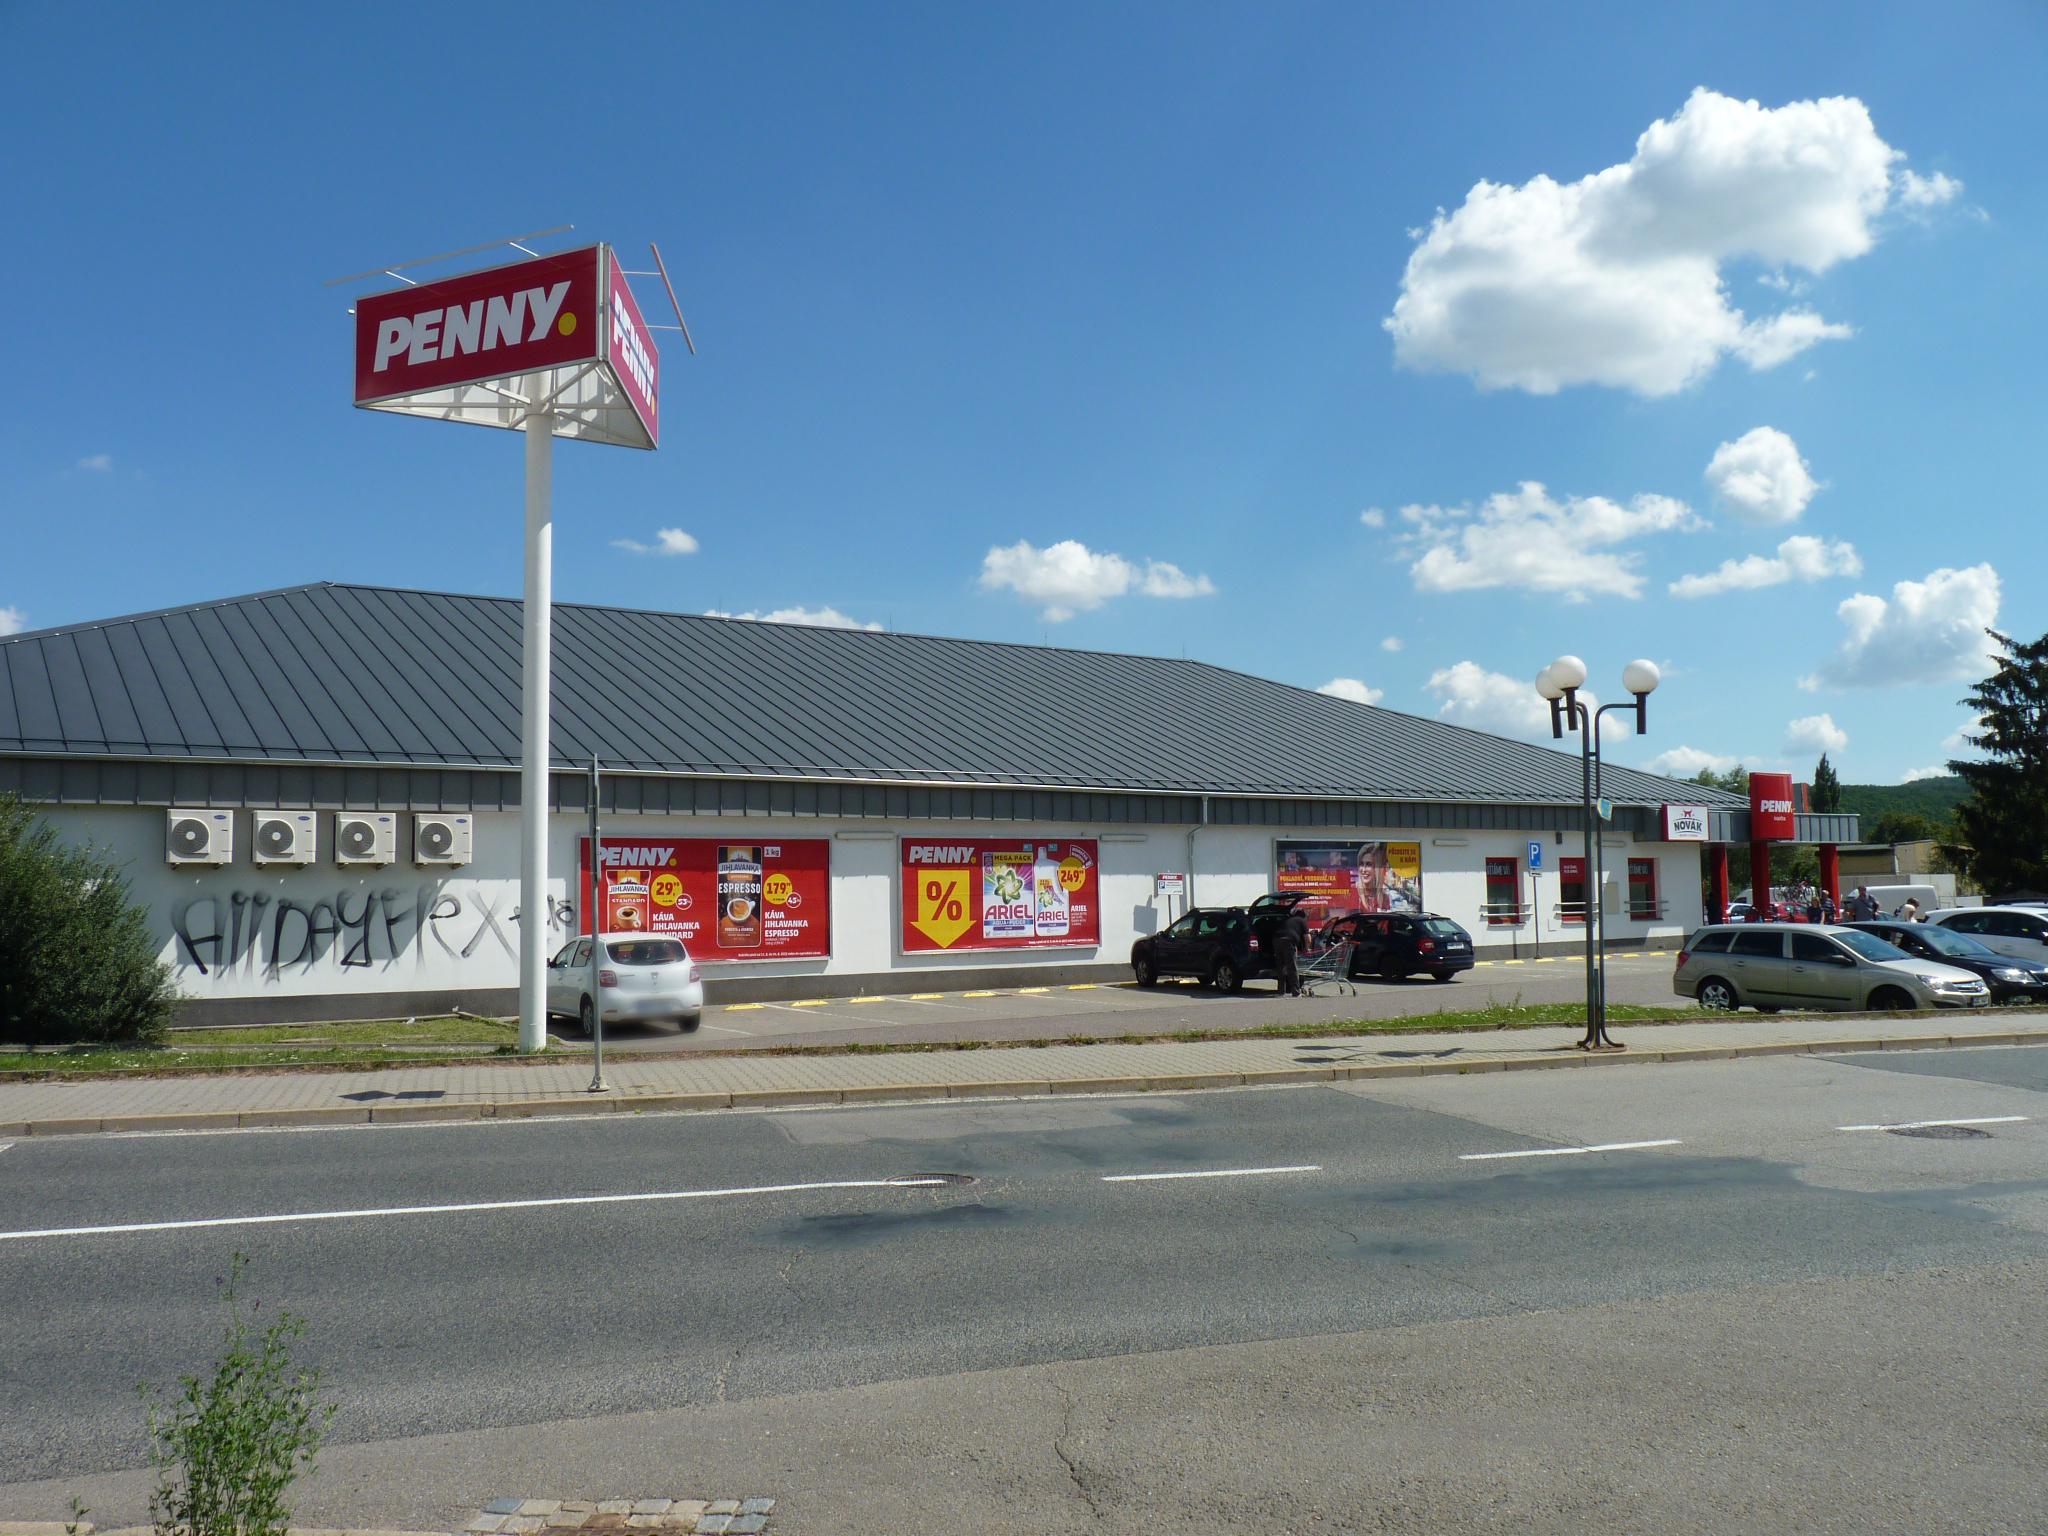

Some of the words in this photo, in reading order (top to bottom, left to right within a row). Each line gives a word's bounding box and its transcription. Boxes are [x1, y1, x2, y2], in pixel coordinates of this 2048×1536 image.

[1531, 844, 1539, 860] P
[719, 863, 760, 873] JIHLAVANKA
[609, 885, 648, 894] JIHLAVANKA
[718, 882, 761, 894] ESPRESSO
[652, 911, 674, 922] KÁVA
[764, 909, 785, 919] KÁVA
[985, 904, 1033, 919] ARIEL
[1037, 911, 1068, 921] ARIEL
[652, 922, 700, 931] JIHLAVANKA
[764, 920, 808, 928] JIHLAVANKA
[764, 929, 799, 937] ESPRESSO
